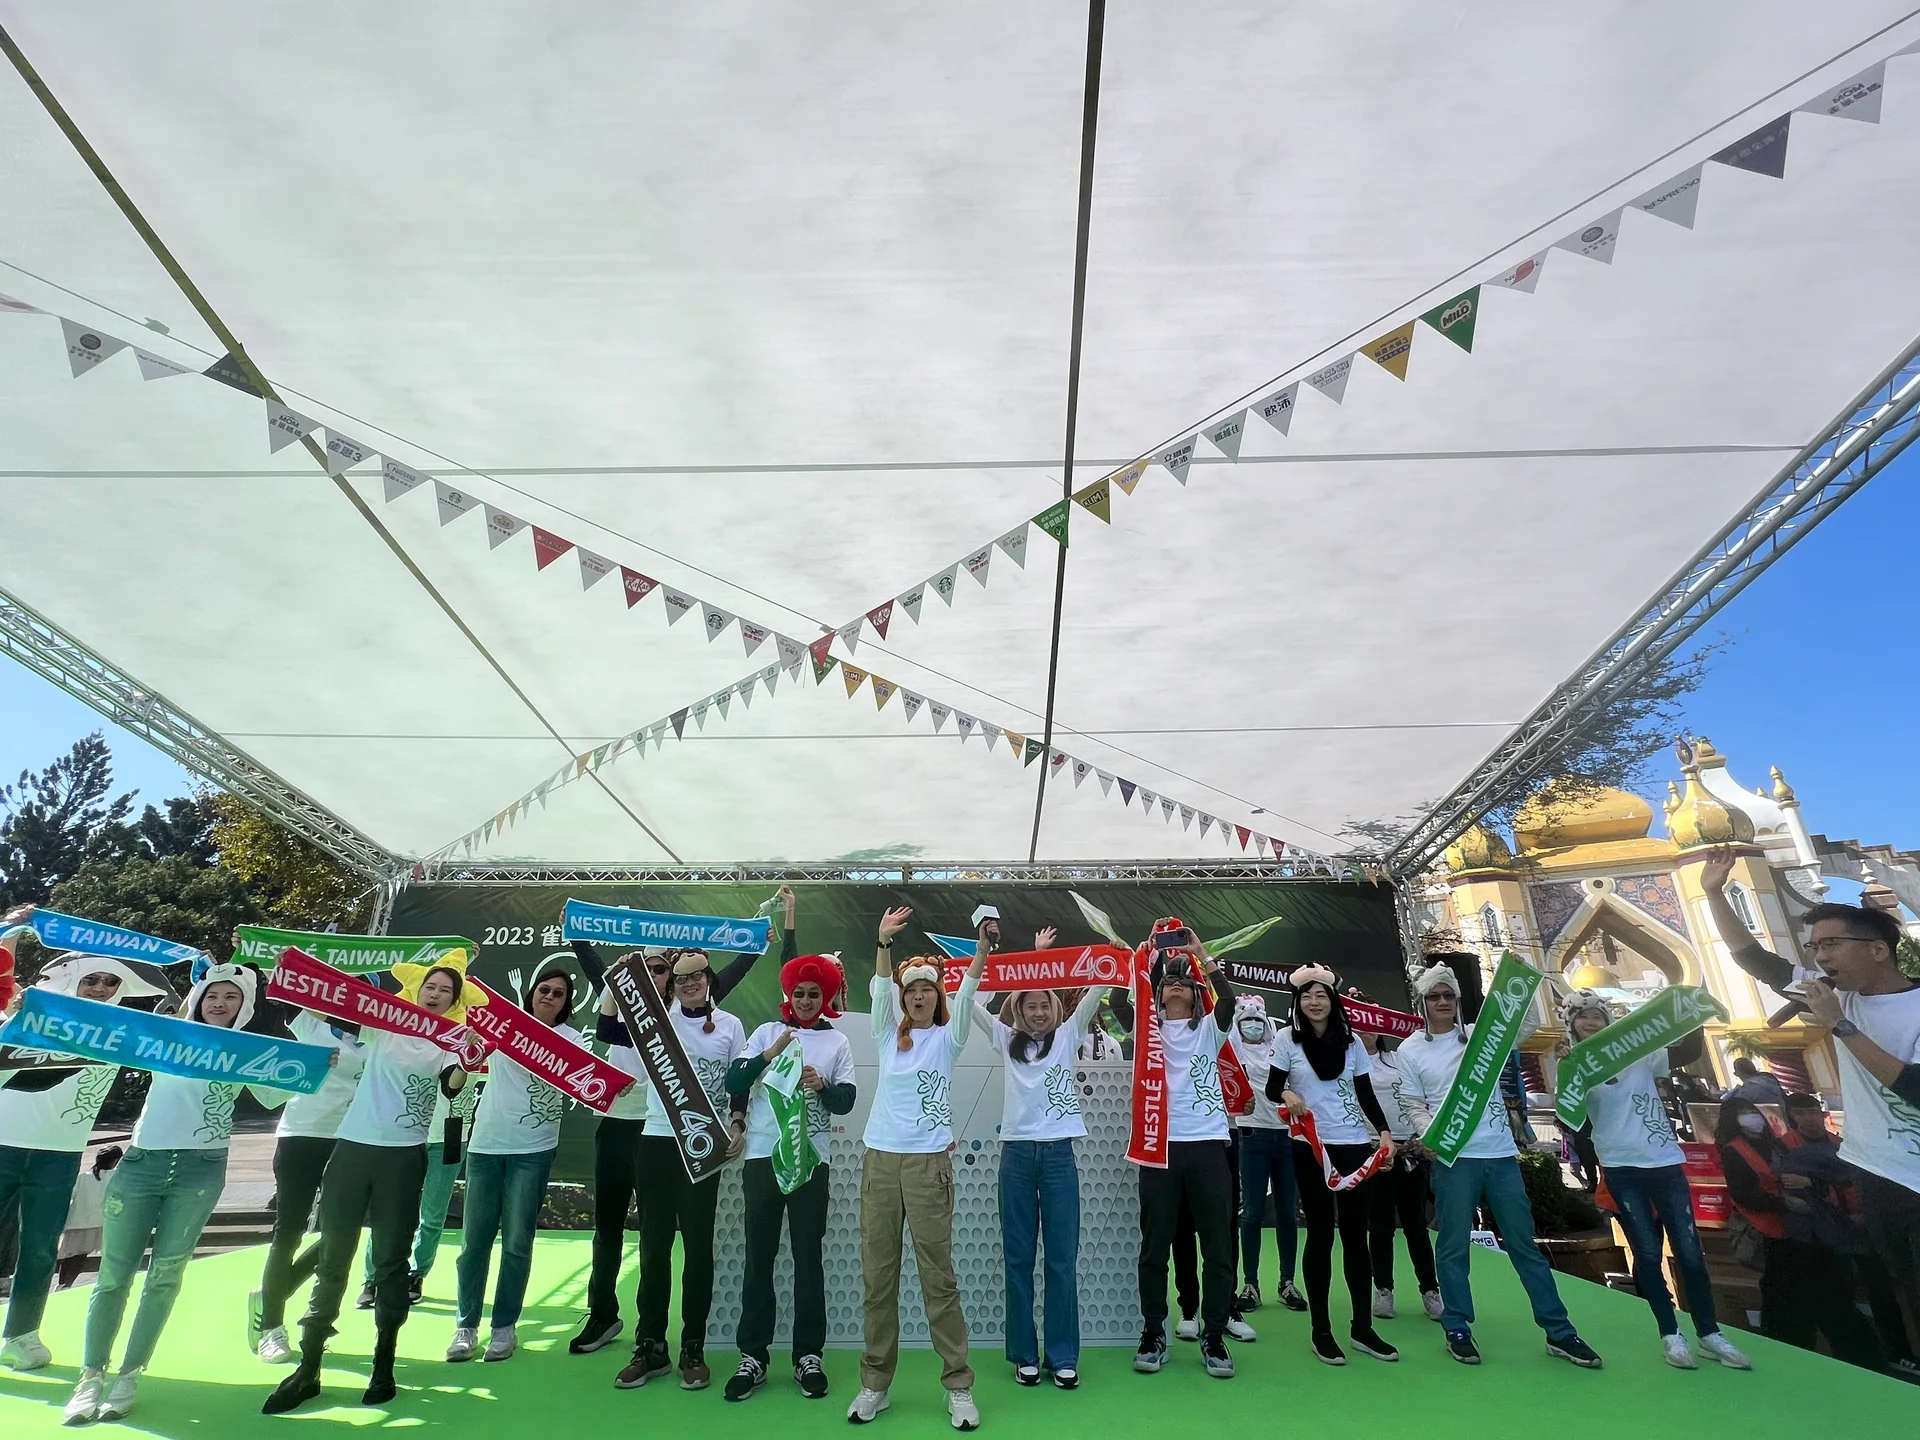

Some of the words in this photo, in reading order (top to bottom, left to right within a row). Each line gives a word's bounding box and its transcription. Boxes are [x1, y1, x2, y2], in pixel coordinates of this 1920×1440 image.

[1832, 83, 1865, 103] MOM
[1643, 178, 1700, 211] NESPRESSO
[1442, 305, 1469, 327] MILO
[279, 415, 299, 428] MOM
[1084, 493, 1101, 507] KLIM
[70, 925, 160, 953] TAIWAN
[482, 926, 535, 945] 2023
[570, 915, 631, 936] NESTLÉ
[639, 922, 704, 941] TAIWAN
[327, 948, 404, 966] TAIWAN
[995, 961, 1064, 981] TAIWAN
[1232, 963, 1288, 985] TAIWAN
[268, 967, 347, 1006] NESTLÉ
[357, 994, 438, 1036] TAIWAN
[1346, 1006, 1384, 1027] ESTLÉ
[22, 1010, 126, 1051] NESTLÉ
[135, 1035, 237, 1073] TAIWAN
[467, 1006, 511, 1039] ESTLÉ
[511, 1031, 568, 1076] TAIWAN
[614, 967, 659, 1034] NESTLÉ
[646, 1033, 689, 1106] TAIWAN
[1600, 1014, 1671, 1061] TAIWAN
[1439, 1086, 1477, 1151] NESTLÉ
[1469, 1019, 1507, 1084] TAIWAN
[1141, 1079, 1163, 1151] NESTLÉ
